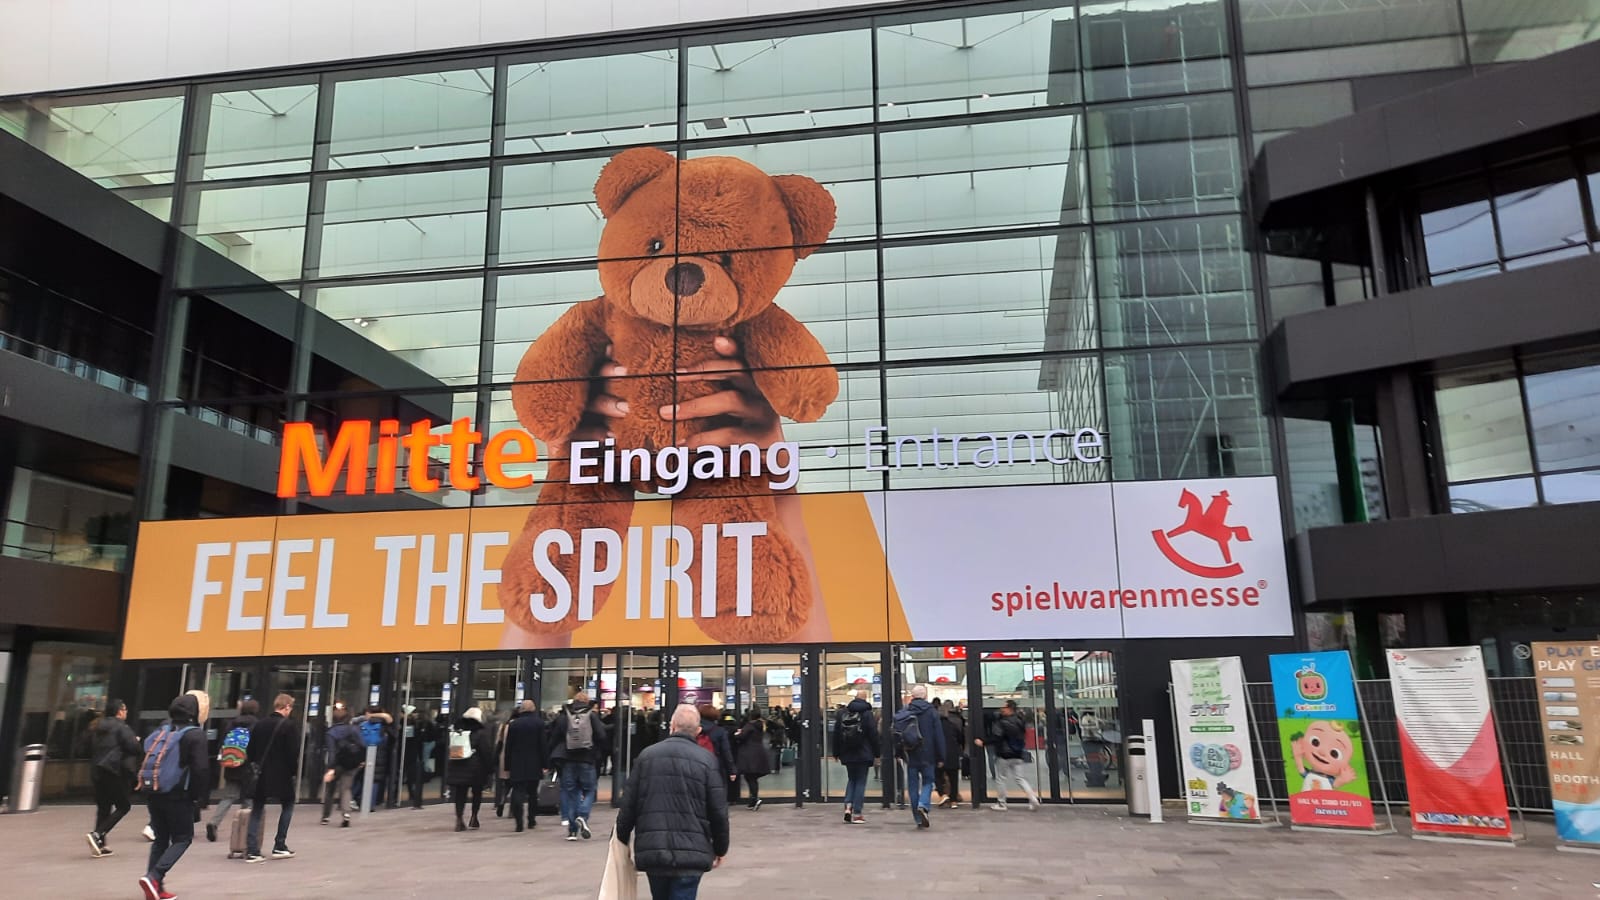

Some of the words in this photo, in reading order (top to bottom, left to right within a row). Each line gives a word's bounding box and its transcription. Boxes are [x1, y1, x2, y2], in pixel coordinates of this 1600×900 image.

[277, 416, 538, 498] Mitte
[569, 438, 800, 494] Eingang
[865, 426, 1104, 471] Entrance
[186, 538, 349, 632] FEEL
[374, 531, 510, 626] THE
[529, 521, 768, 623] SPIRIT
[1546, 646, 1584, 657] PLAY
[1538, 660, 1576, 671] PLAY
[1550, 751, 1584, 760] HALL
[1553, 774, 1600, 785] BOOTH
